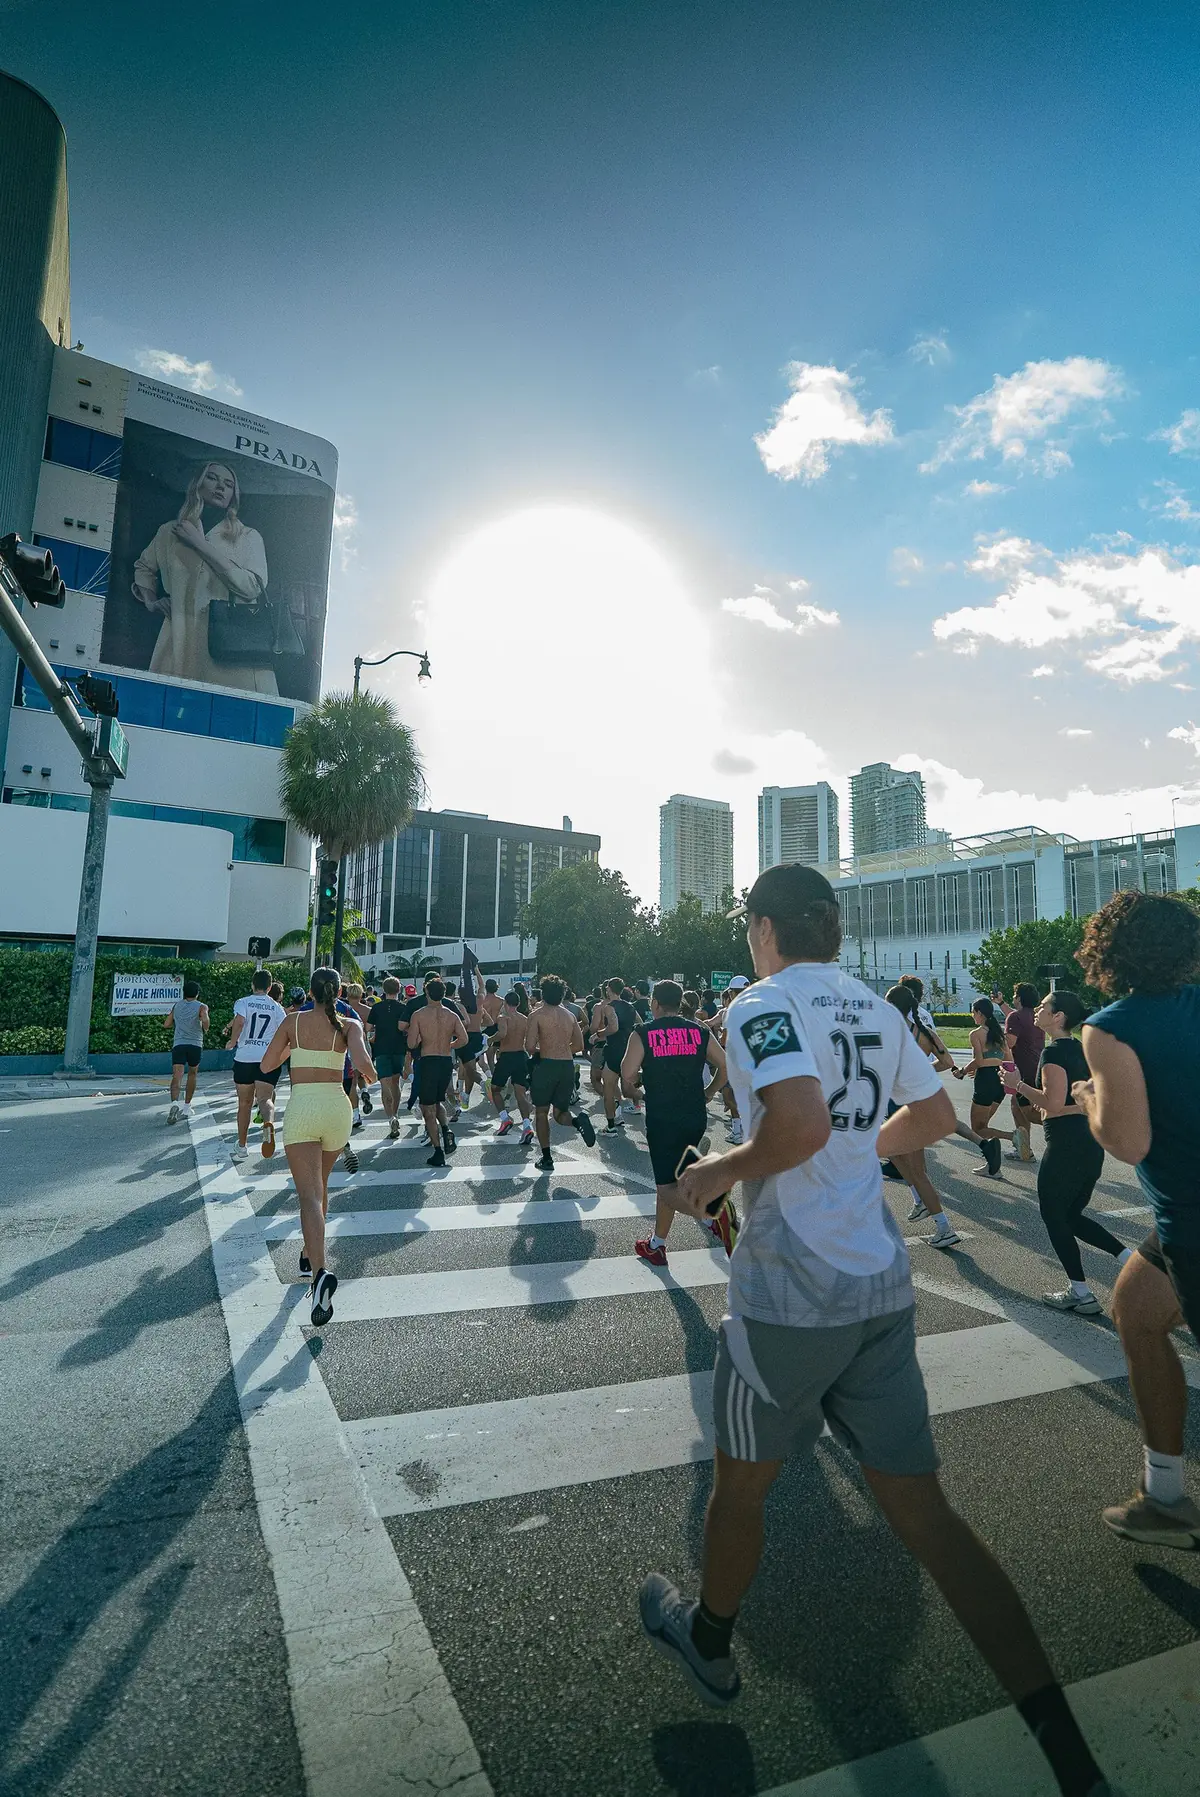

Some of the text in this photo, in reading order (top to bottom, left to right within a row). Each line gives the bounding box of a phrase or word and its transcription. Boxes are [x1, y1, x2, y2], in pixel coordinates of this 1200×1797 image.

[137, 387, 195, 410] PHOTOGRAPHED
[195, 405, 204, 414] BY
[138, 381, 174, 397] SCARLETT
[176, 395, 215, 412] JOHANSSON
[253, 420, 266, 429] BAG
[235, 435, 322, 477] PRADA
[115, 988, 181, 999] WE ARE HIRING!
[116, 976, 173, 984] BORINQUEN
[249, 1012, 271, 1039] 17
[648, 1029, 667, 1047] IT'S
[689, 1028, 701, 1047] TO
[827, 1029, 883, 1131] 25
